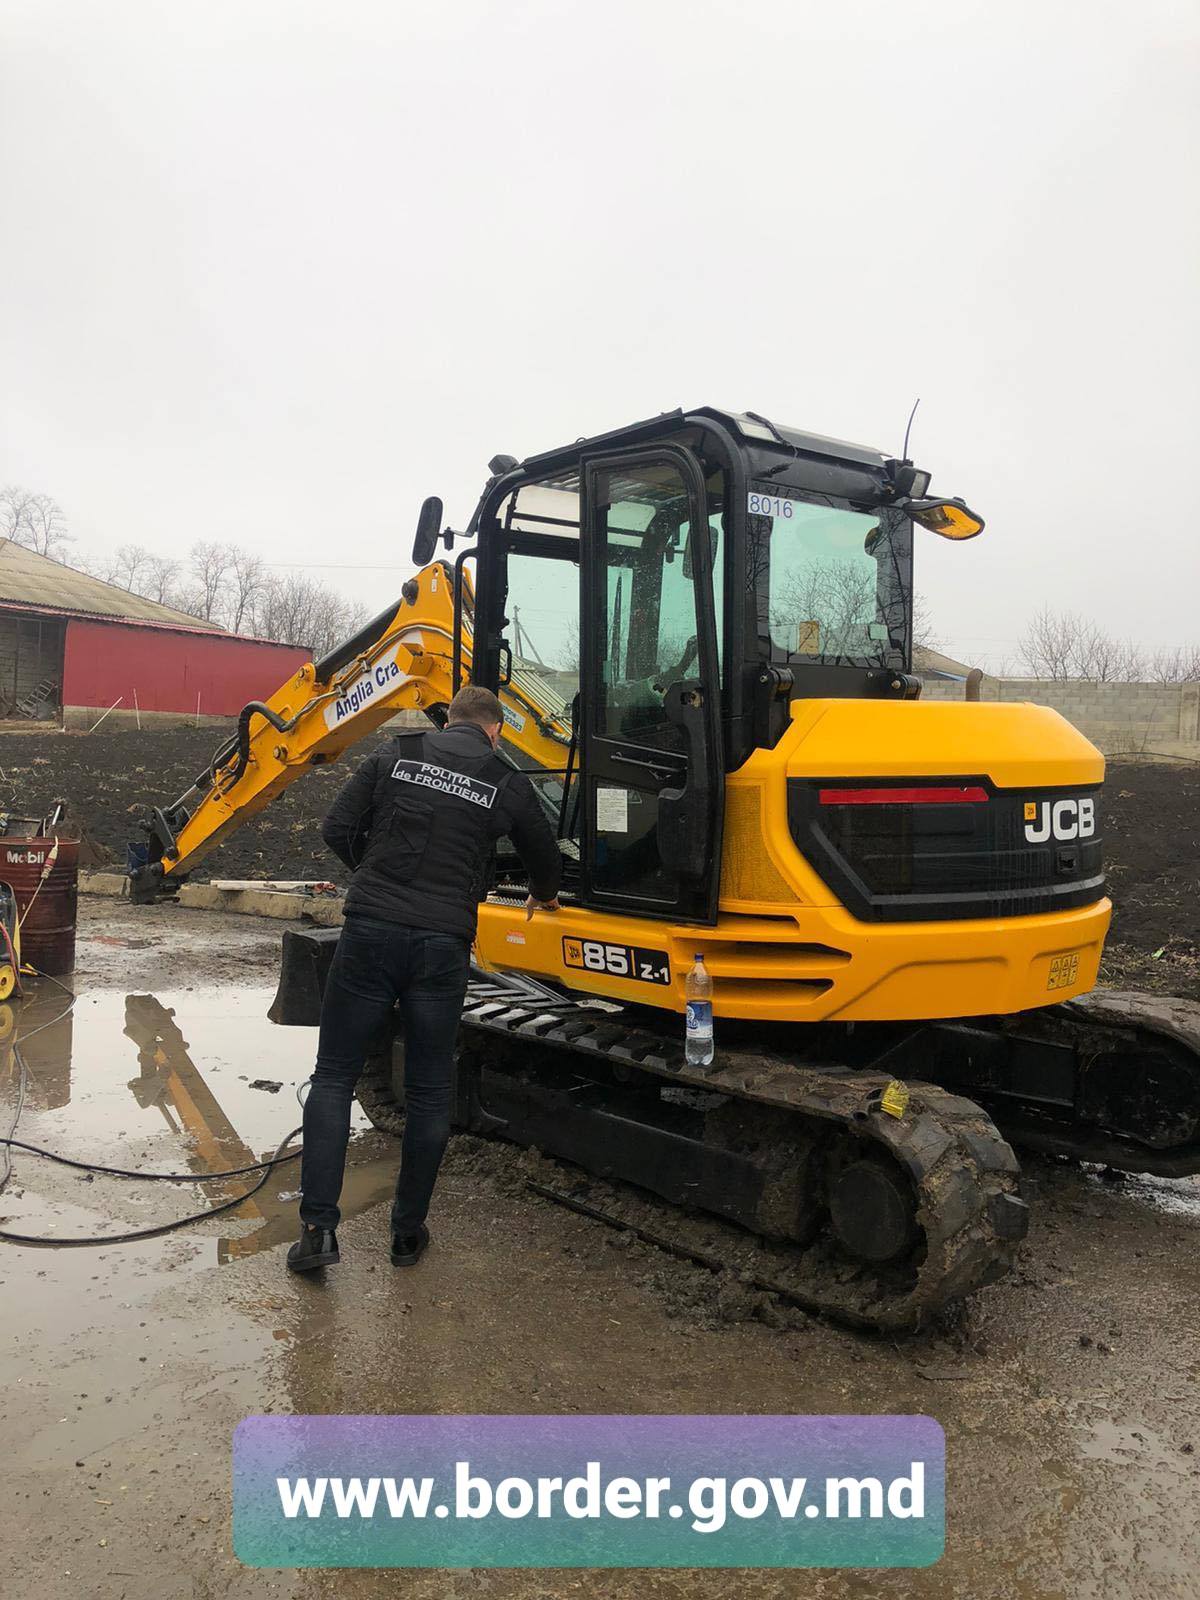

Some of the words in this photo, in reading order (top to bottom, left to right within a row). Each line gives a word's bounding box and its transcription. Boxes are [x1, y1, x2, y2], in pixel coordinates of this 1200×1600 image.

[750, 495, 793, 519] 8016
[336, 681, 374, 720] Anglia
[395, 770, 411, 780] de
[415, 774, 489, 806] FRONTIERĂ
[1024, 798, 1095, 843] JCB
[7, 850, 45, 864] Mobil
[583, 942, 629, 975] 85
